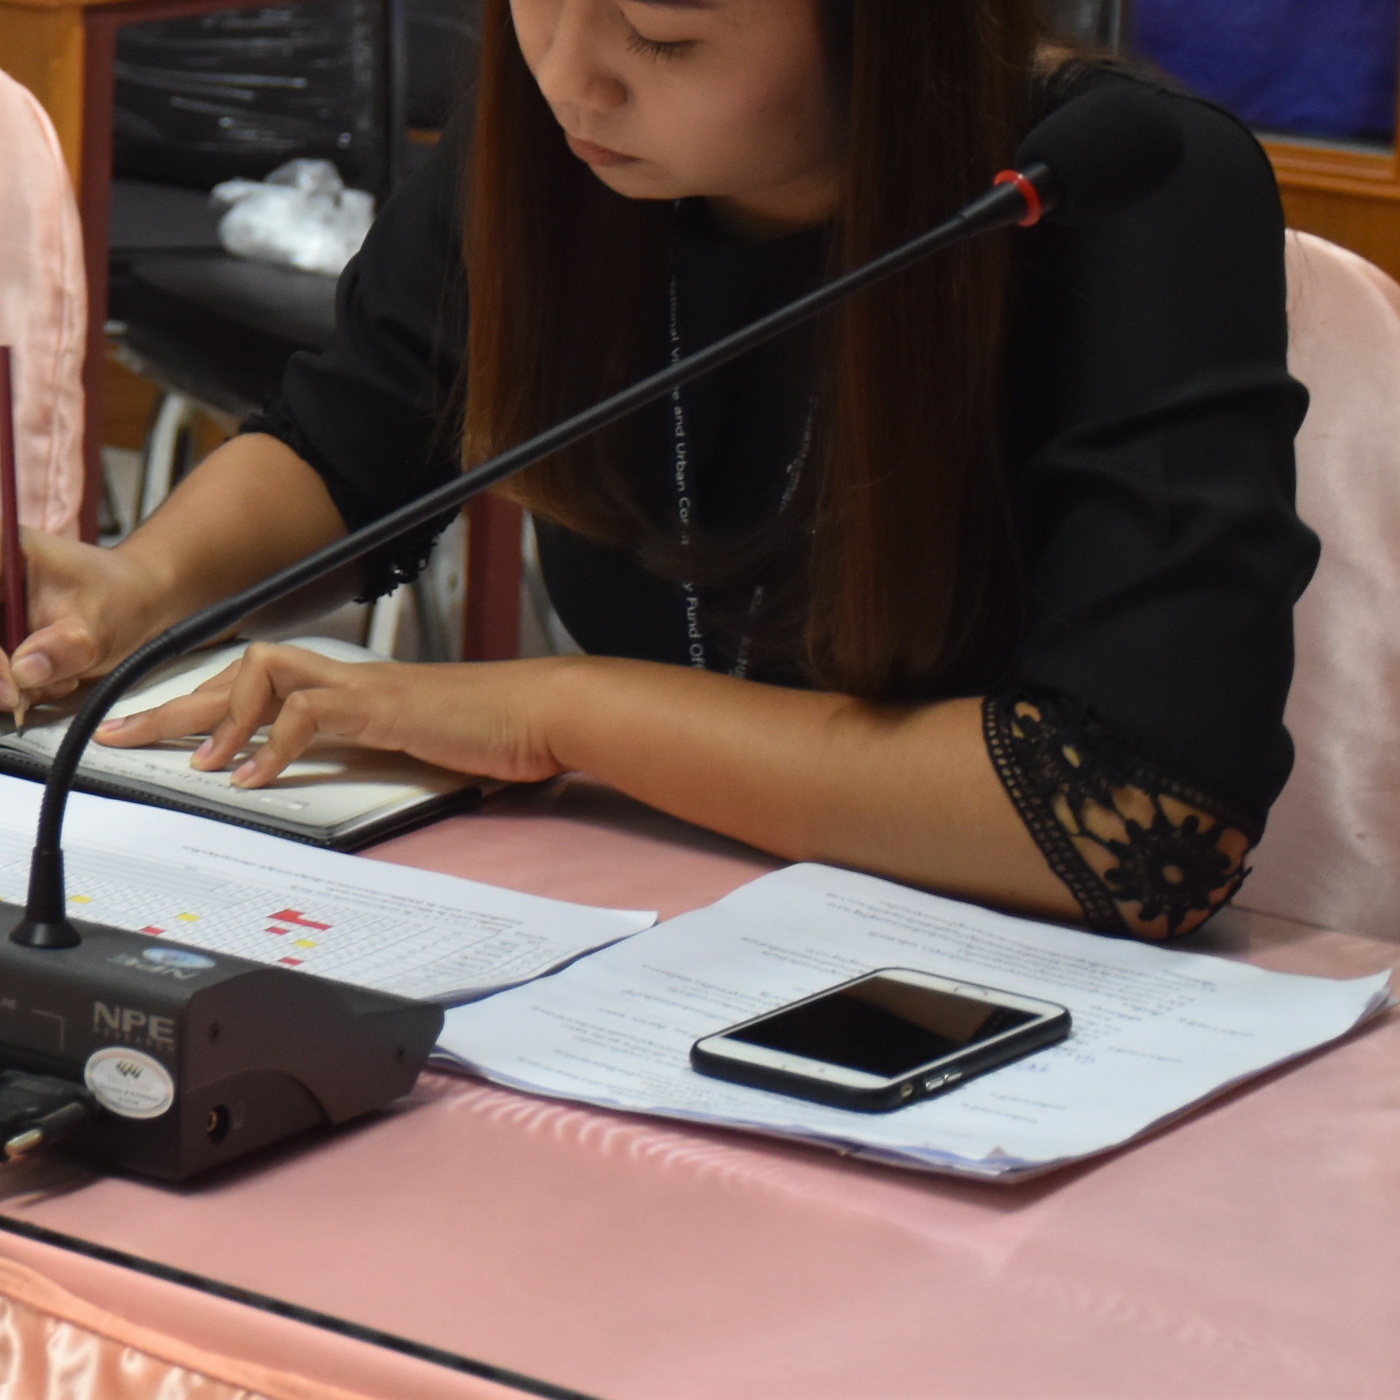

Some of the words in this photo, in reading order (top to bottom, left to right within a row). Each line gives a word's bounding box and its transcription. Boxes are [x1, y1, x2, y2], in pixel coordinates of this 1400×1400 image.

[674, 406, 684, 437] and
[675, 442, 690, 493] Urban
[685, 596, 703, 639] Fund
[93, 1000, 175, 1044] NPE
